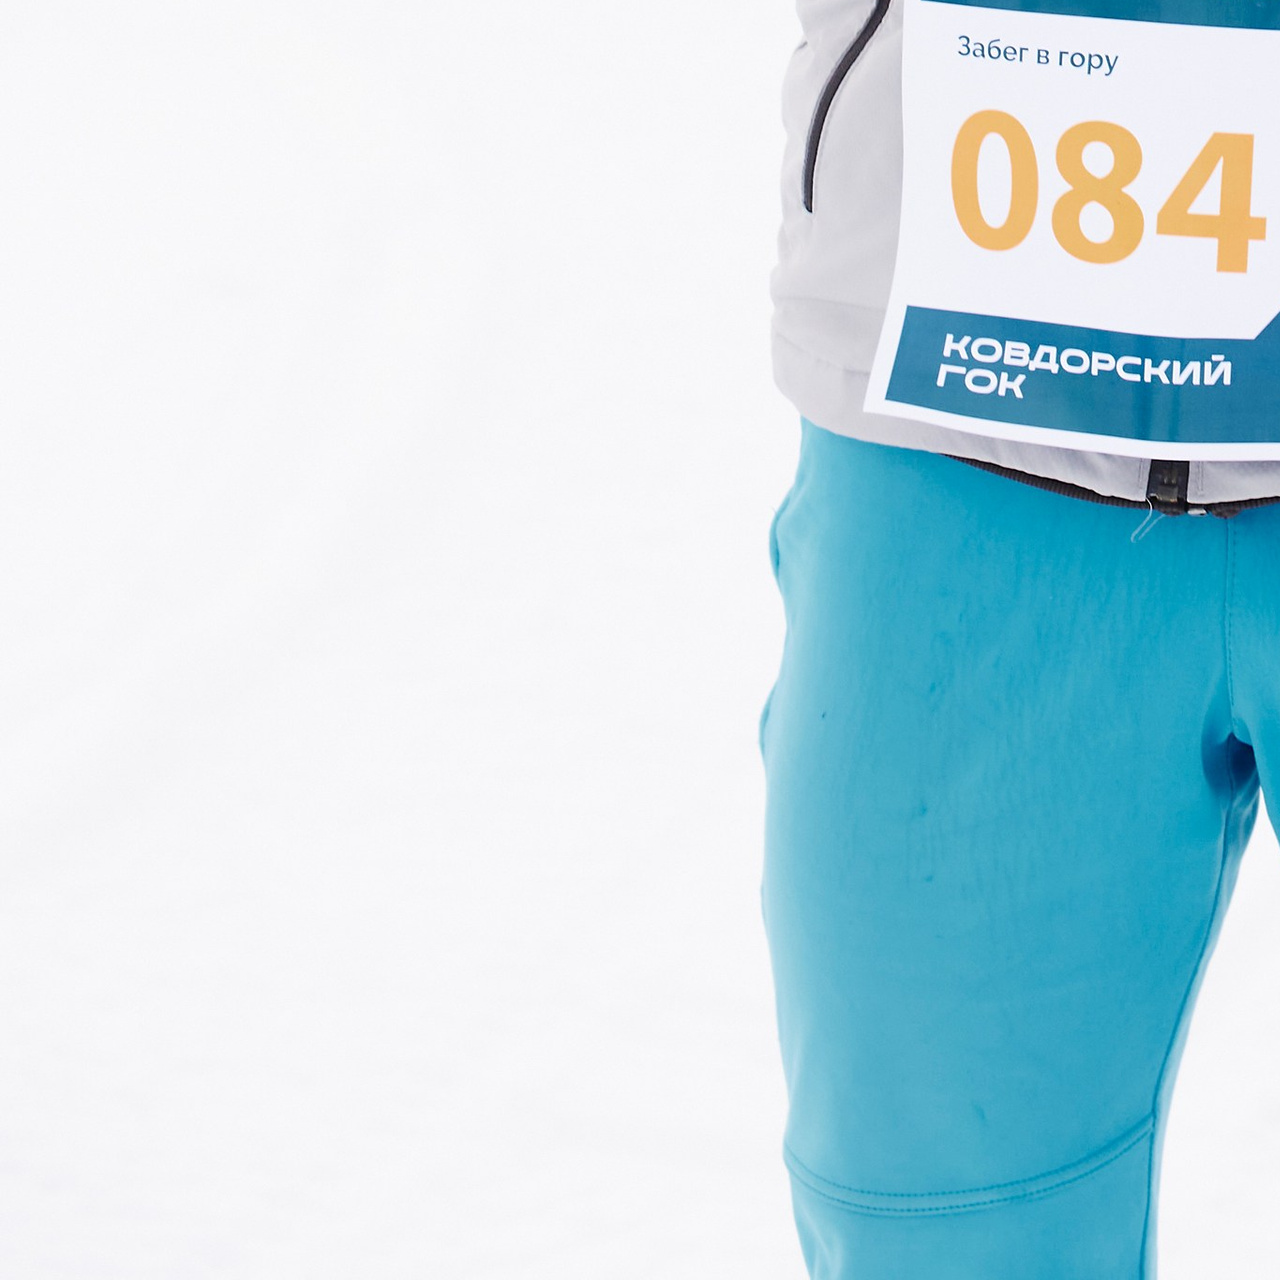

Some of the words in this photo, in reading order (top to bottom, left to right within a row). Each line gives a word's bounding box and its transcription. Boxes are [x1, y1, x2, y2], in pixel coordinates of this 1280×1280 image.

[957, 35, 1029, 63] Забег
[1036, 48, 1050, 65] в
[1058, 50, 1119, 76] гору
[950, 109, 1268, 274] 084
[936, 363, 1027, 399] ГОК
[942, 333, 1233, 387] КОВДОРСКИЙ
